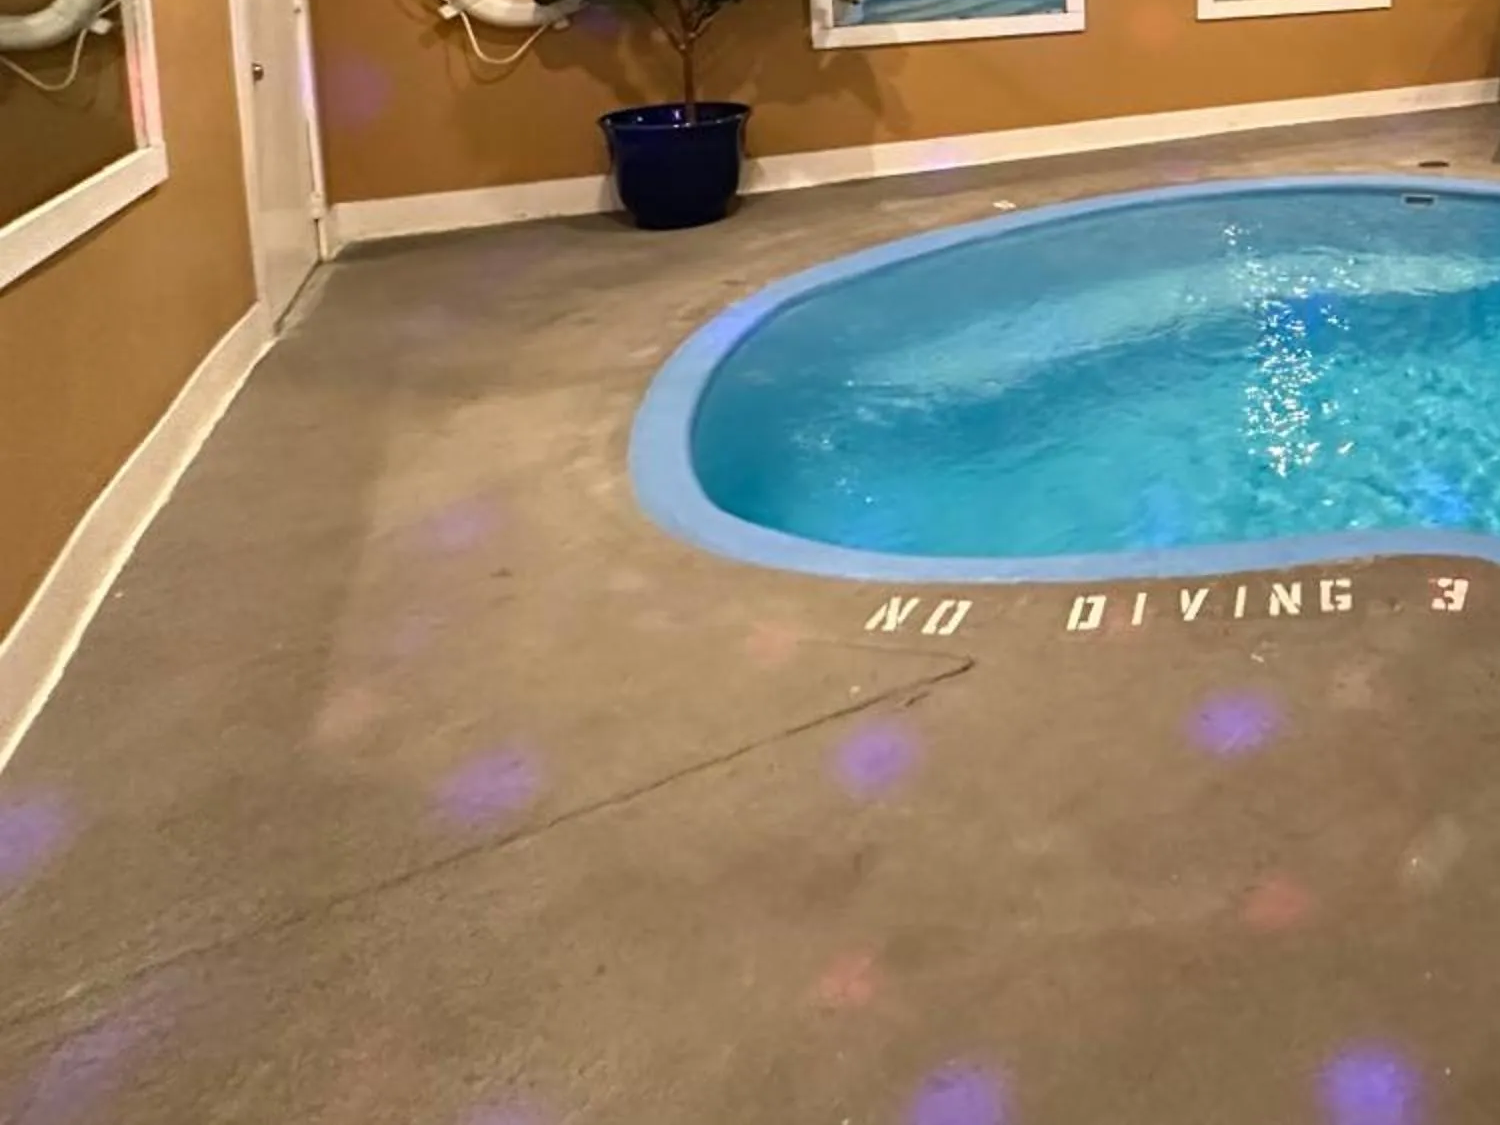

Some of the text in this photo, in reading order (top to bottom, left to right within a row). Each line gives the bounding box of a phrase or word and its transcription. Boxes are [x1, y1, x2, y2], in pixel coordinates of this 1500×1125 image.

[865, 578, 1469, 635] NO DIVING 3
